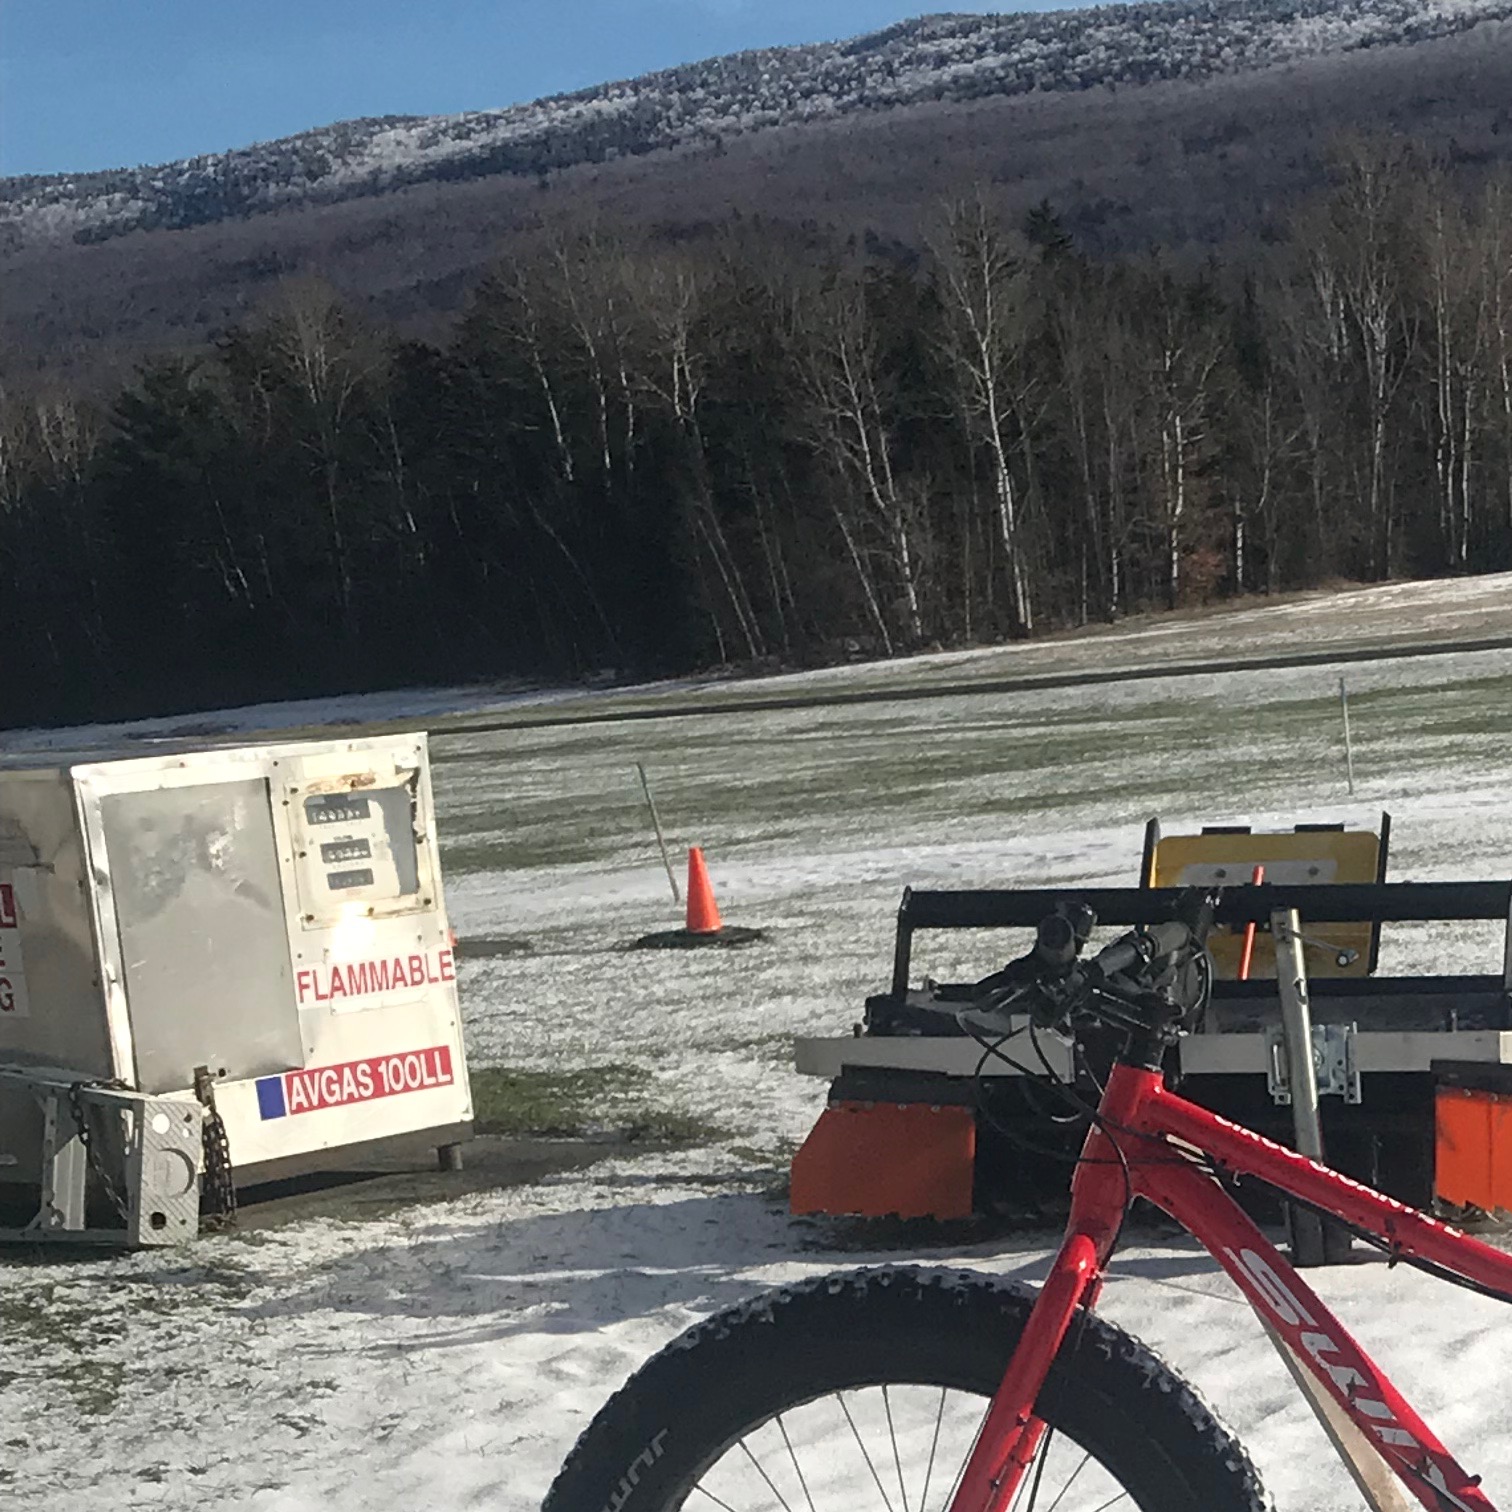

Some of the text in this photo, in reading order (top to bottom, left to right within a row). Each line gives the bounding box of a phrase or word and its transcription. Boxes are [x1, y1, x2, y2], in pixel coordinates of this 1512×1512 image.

[297, 950, 455, 1003] FLAMMABLE
[291, 1051, 451, 1111] AVGAS 100LL
